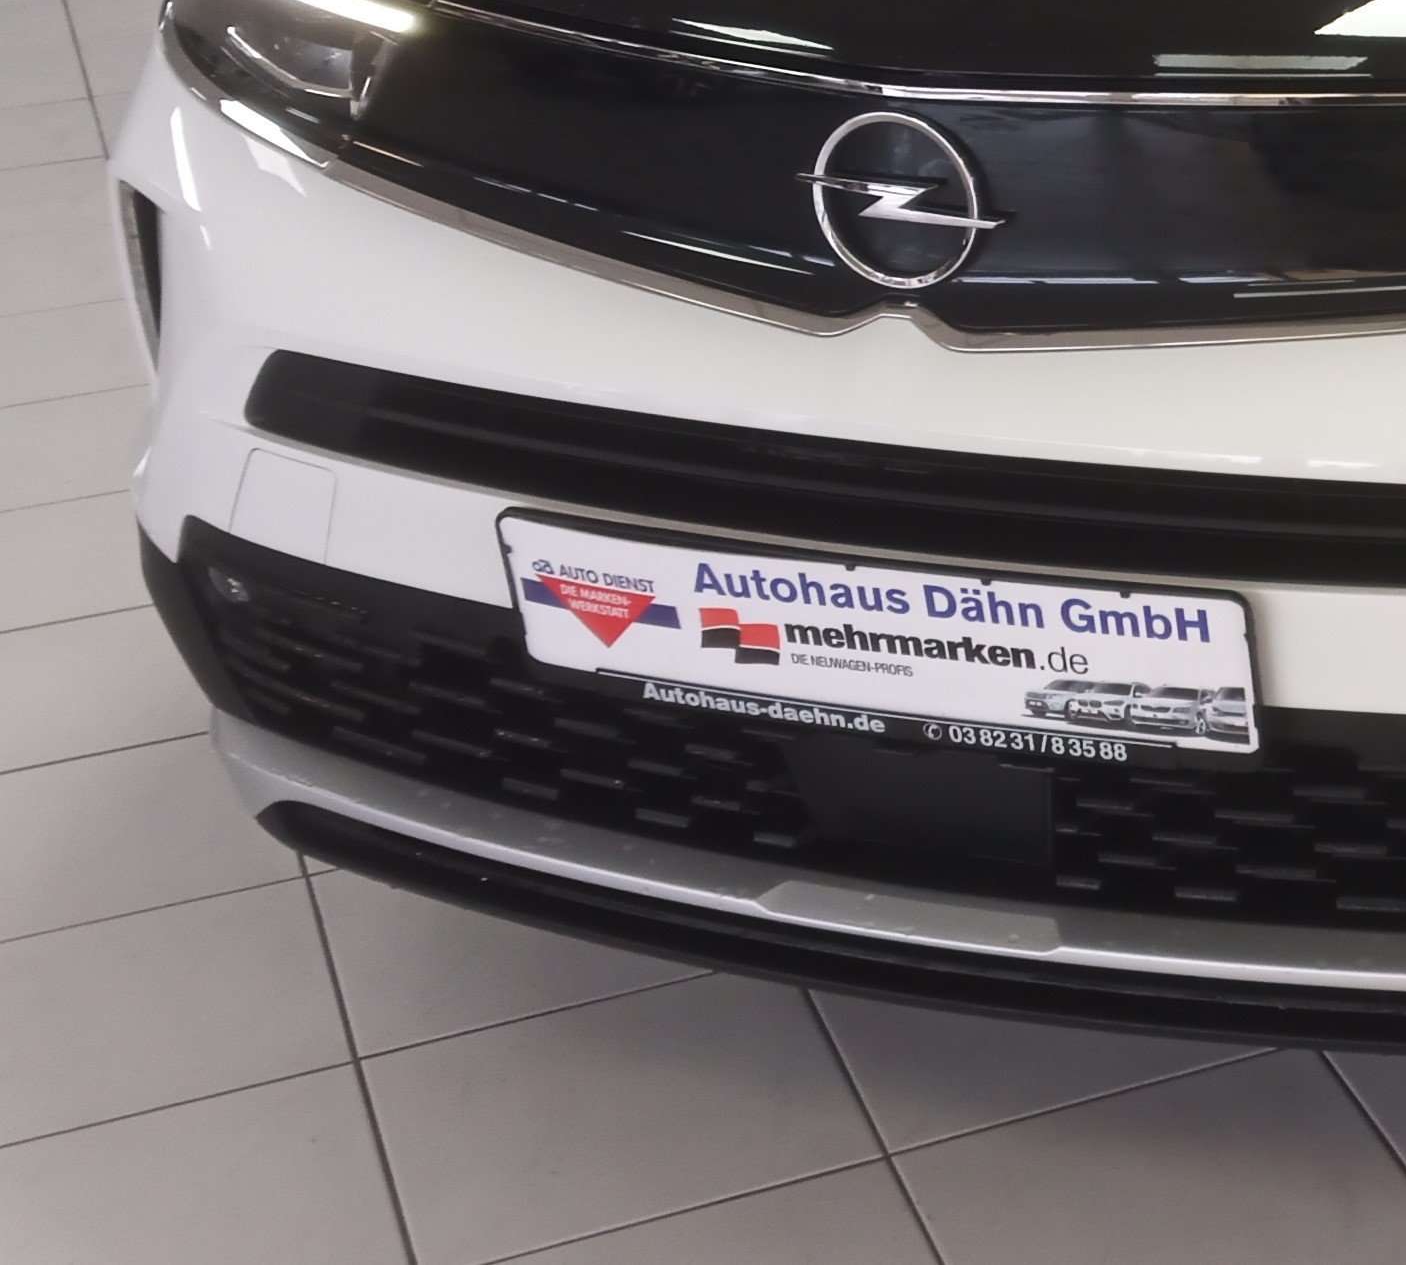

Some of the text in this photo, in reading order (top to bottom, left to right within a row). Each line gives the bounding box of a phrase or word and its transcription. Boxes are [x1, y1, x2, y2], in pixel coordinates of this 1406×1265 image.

[559, 564, 656, 593] AUTO DIENST
[560, 584, 578, 597] DIE
[694, 562, 1211, 643] Autohaus Dähn GmbH
[784, 623, 1089, 675] mehrmarken.de
[790, 653, 914, 677] DIE NEUWAGEN-PROFIS
[643, 682, 886, 734] Autohaus-daehn.de
